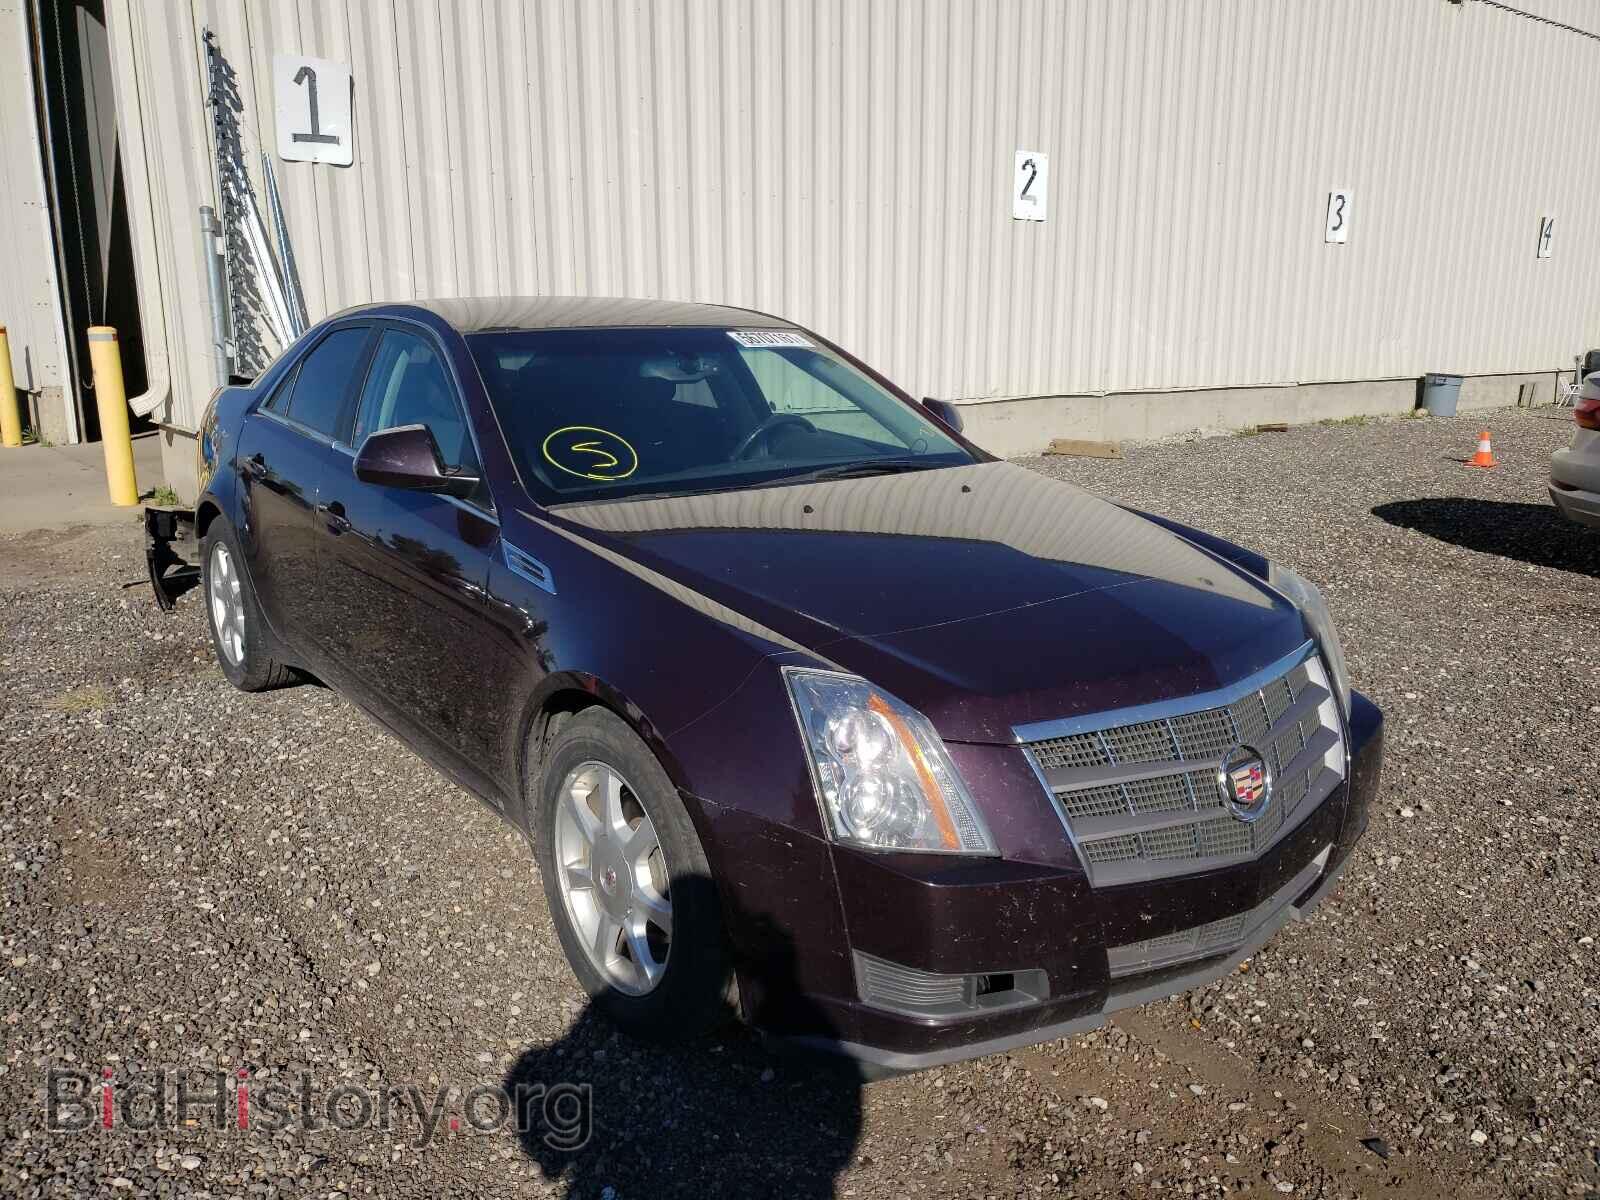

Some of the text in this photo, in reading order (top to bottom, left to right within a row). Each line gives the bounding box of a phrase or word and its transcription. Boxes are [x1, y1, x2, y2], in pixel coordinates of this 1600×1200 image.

[293, 66, 340, 145] 1
[1020, 158, 1037, 206] 2
[1332, 194, 1346, 231] 3
[1543, 218, 1554, 250] 4
